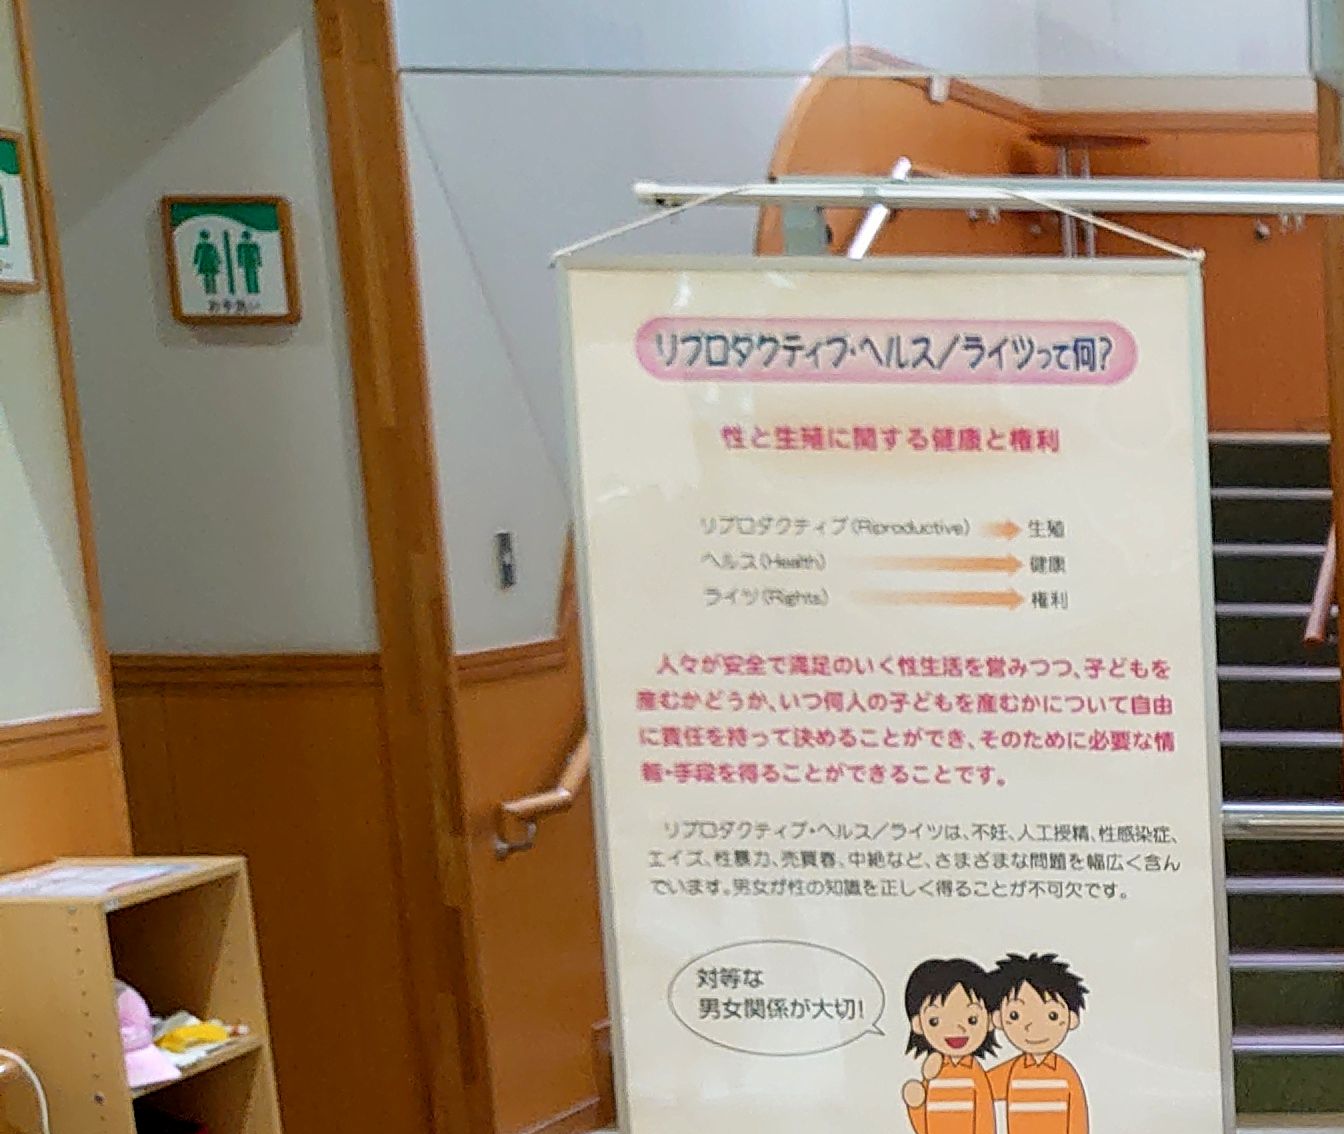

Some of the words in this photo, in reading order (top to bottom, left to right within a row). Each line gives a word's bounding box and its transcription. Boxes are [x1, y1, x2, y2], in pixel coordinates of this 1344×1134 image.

[720, 426, 1059, 454] 性と生殖に関する健康と権利
[1029, 554, 1066, 575] 健康
[1030, 590, 1068, 612] 権利
[697, 967, 765, 990] 対等な
